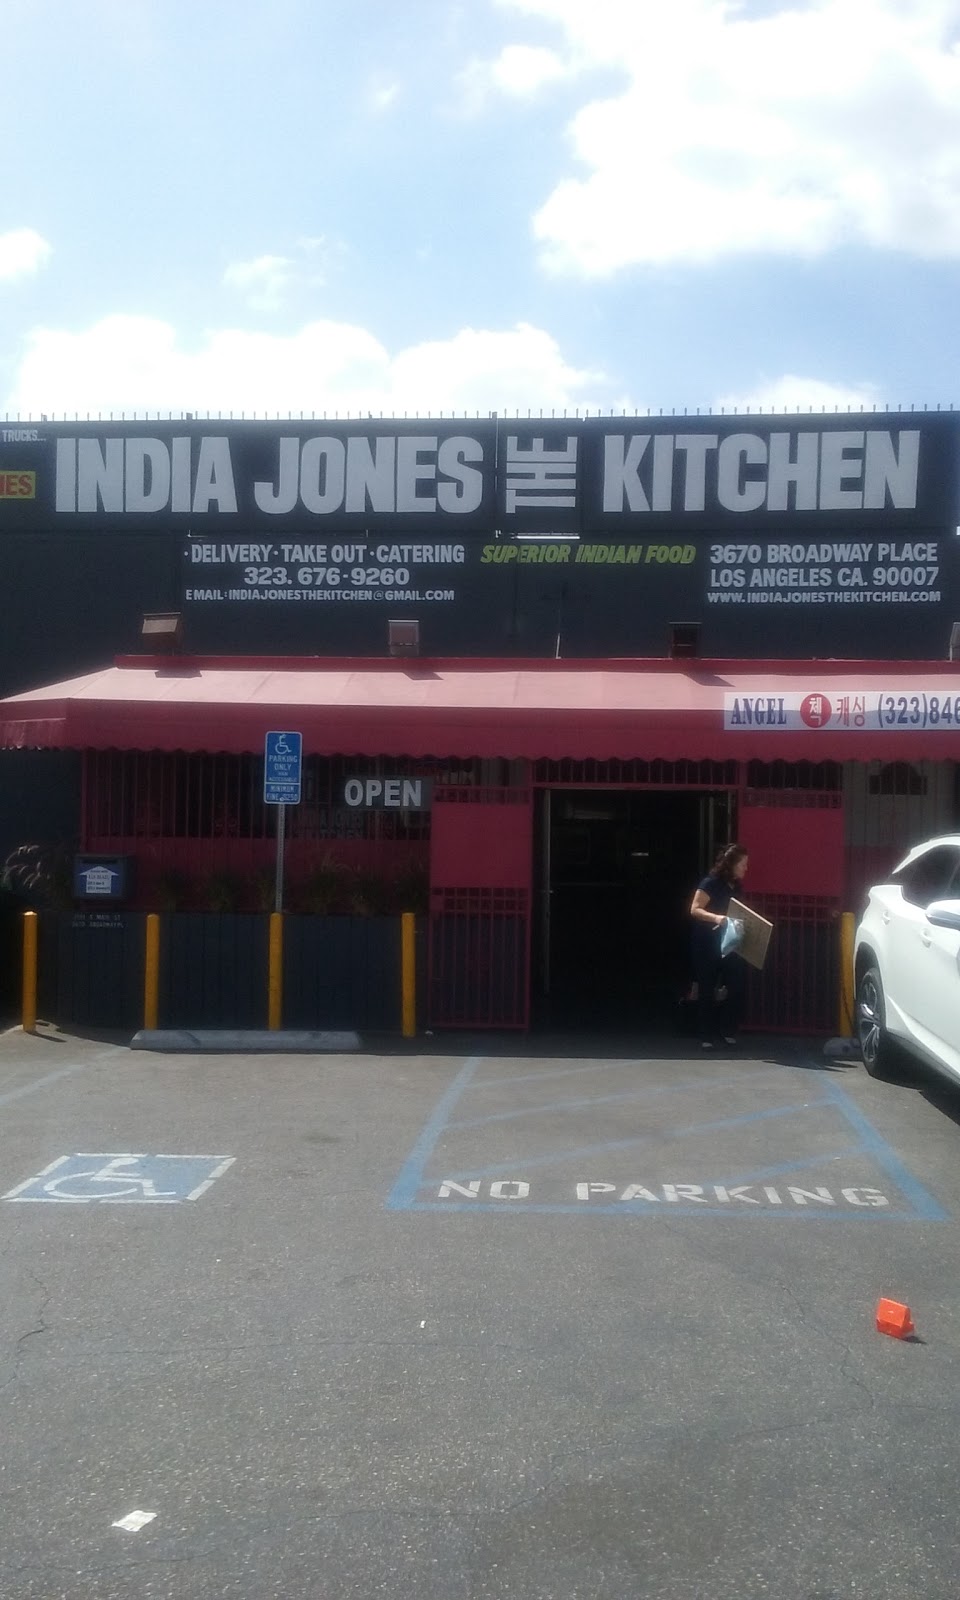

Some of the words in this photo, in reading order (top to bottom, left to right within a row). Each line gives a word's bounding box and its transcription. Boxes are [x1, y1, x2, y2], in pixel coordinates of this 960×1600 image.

[55, 437, 238, 512] INDIA
[254, 436, 484, 514] JONES
[506, 436, 578, 513] THE
[603, 430, 920, 512] KITCHEN
[480, 545, 571, 563] SUPERIOR
[575, 545, 642, 563] INDIAN
[644, 545, 696, 564] FOOD
[710, 544, 762, 563] 3670
[767, 543, 873, 563] BROADWAY
[878, 543, 938, 561] PLACE
[711, 568, 746, 587] LOS
[749, 568, 832, 587] ANGELES
[837, 567, 868, 586] CA.
[872, 566, 939, 586] 90007
[731, 698, 787, 725] ANGEL
[269, 755, 298, 763] PARKING
[274, 763, 292, 771] ONLY
[344, 779, 421, 806] OPEN
[438, 1180, 530, 1199] NO
[576, 1182, 889, 1207] PARKING
